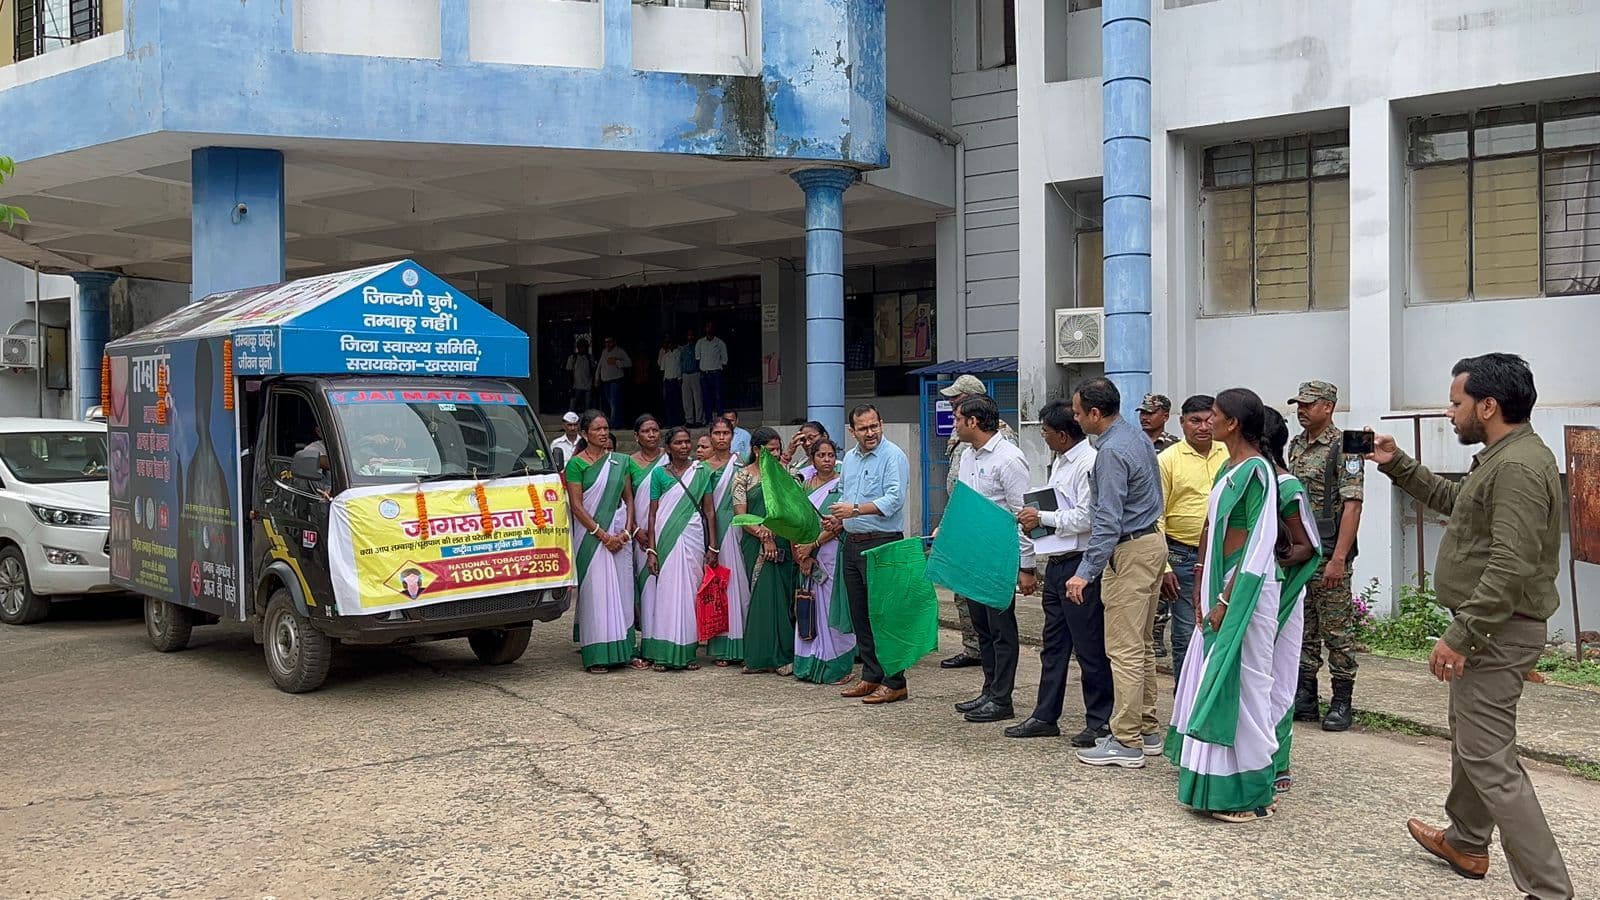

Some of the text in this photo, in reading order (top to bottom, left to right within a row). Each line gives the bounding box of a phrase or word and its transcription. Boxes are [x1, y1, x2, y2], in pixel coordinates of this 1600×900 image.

[362, 286, 424, 308] जिन्दगी
[362, 313, 458, 334] तम्बाकू नहीं।
[235, 334, 257, 352] तम्बाकू
[340, 335, 482, 356] जिला स्वास्थ्य समिति,
[238, 352, 272, 375] जीवन चुनो
[352, 391, 503, 402] JAI MATA DI
[448, 561, 490, 571] NATIONAL
[492, 554, 531, 564] TOBACCO
[451, 559, 560, 584] 1800-11-2356
